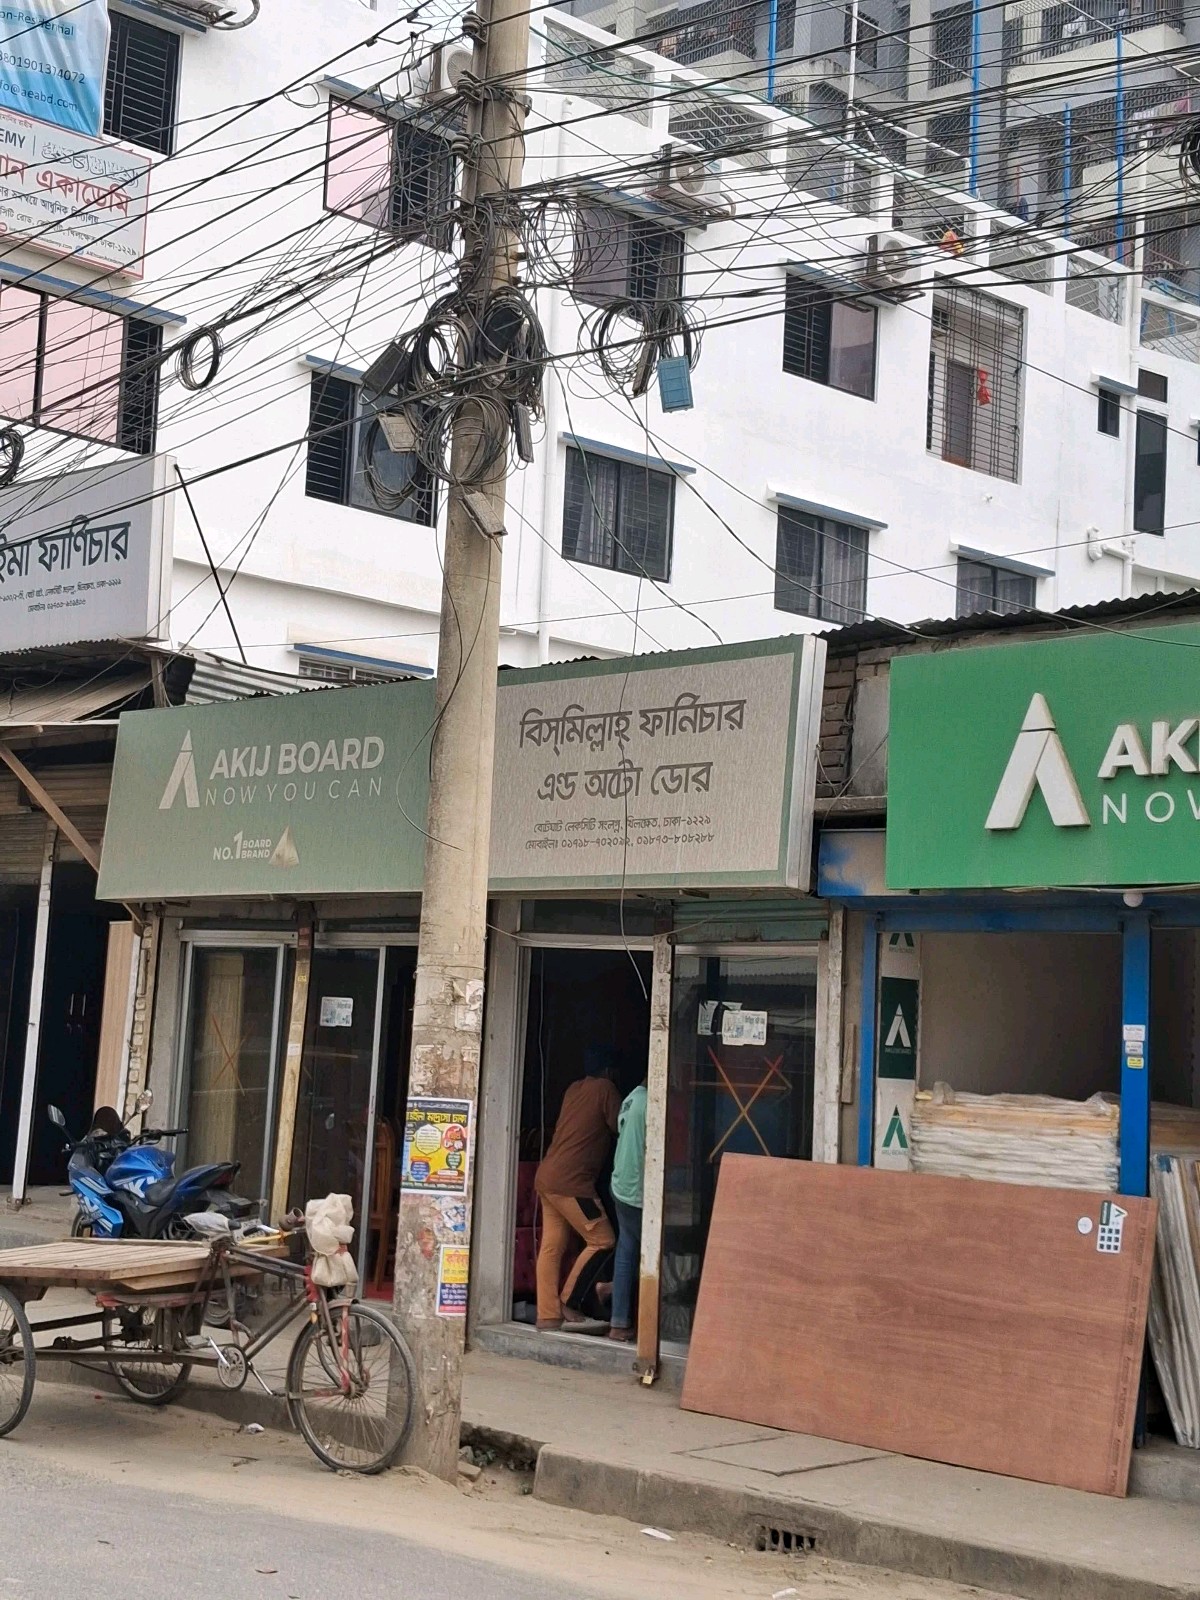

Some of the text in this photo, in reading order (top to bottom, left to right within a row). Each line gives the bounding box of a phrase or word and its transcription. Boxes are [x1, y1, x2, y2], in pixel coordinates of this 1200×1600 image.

[209, 736, 385, 780] AKIJ BOARD
[1097, 719, 1200, 778] AK
[205, 776, 383, 807] NOW YOU CAN
[650, 761, 713, 796] ডোর
[663, 816, 712, 828] ঢাকা-১২২৯
[241, 849, 270, 859] BRAND
[242, 838, 272, 849] BOARD
